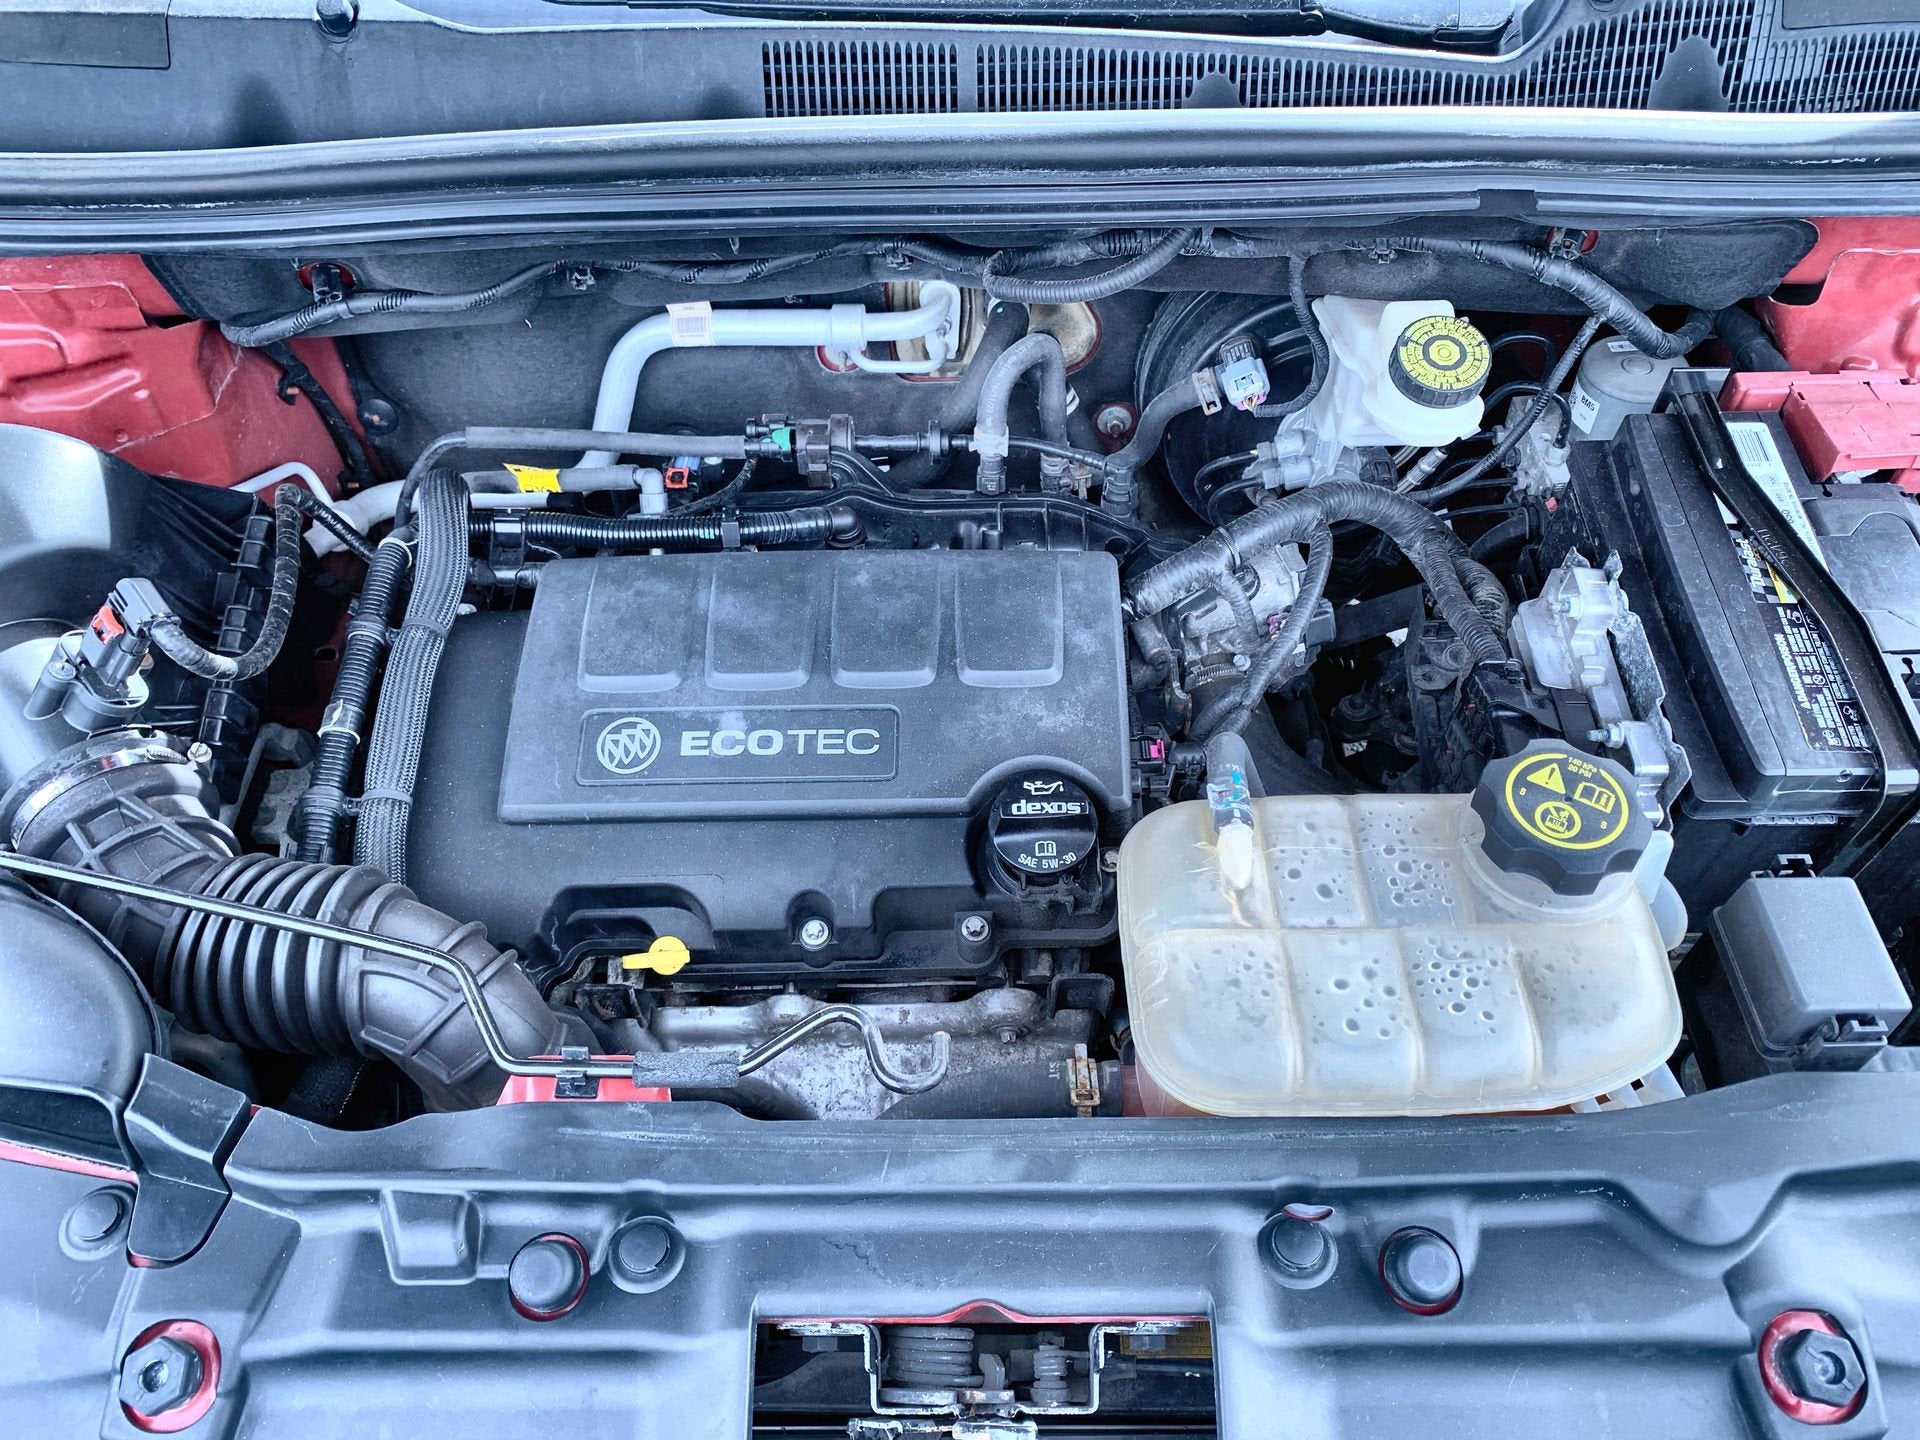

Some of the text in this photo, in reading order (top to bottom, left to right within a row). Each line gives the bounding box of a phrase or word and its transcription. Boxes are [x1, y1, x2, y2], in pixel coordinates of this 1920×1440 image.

[1736, 538, 1765, 588] Duralast
[680, 729, 880, 756] ECOTEC
[1568, 757, 1597, 773] 140 kPa
[1568, 764, 1592, 778] 20 PSI
[1012, 799, 1081, 815] dexos
[1018, 852, 1076, 869] SAE 5W-30
